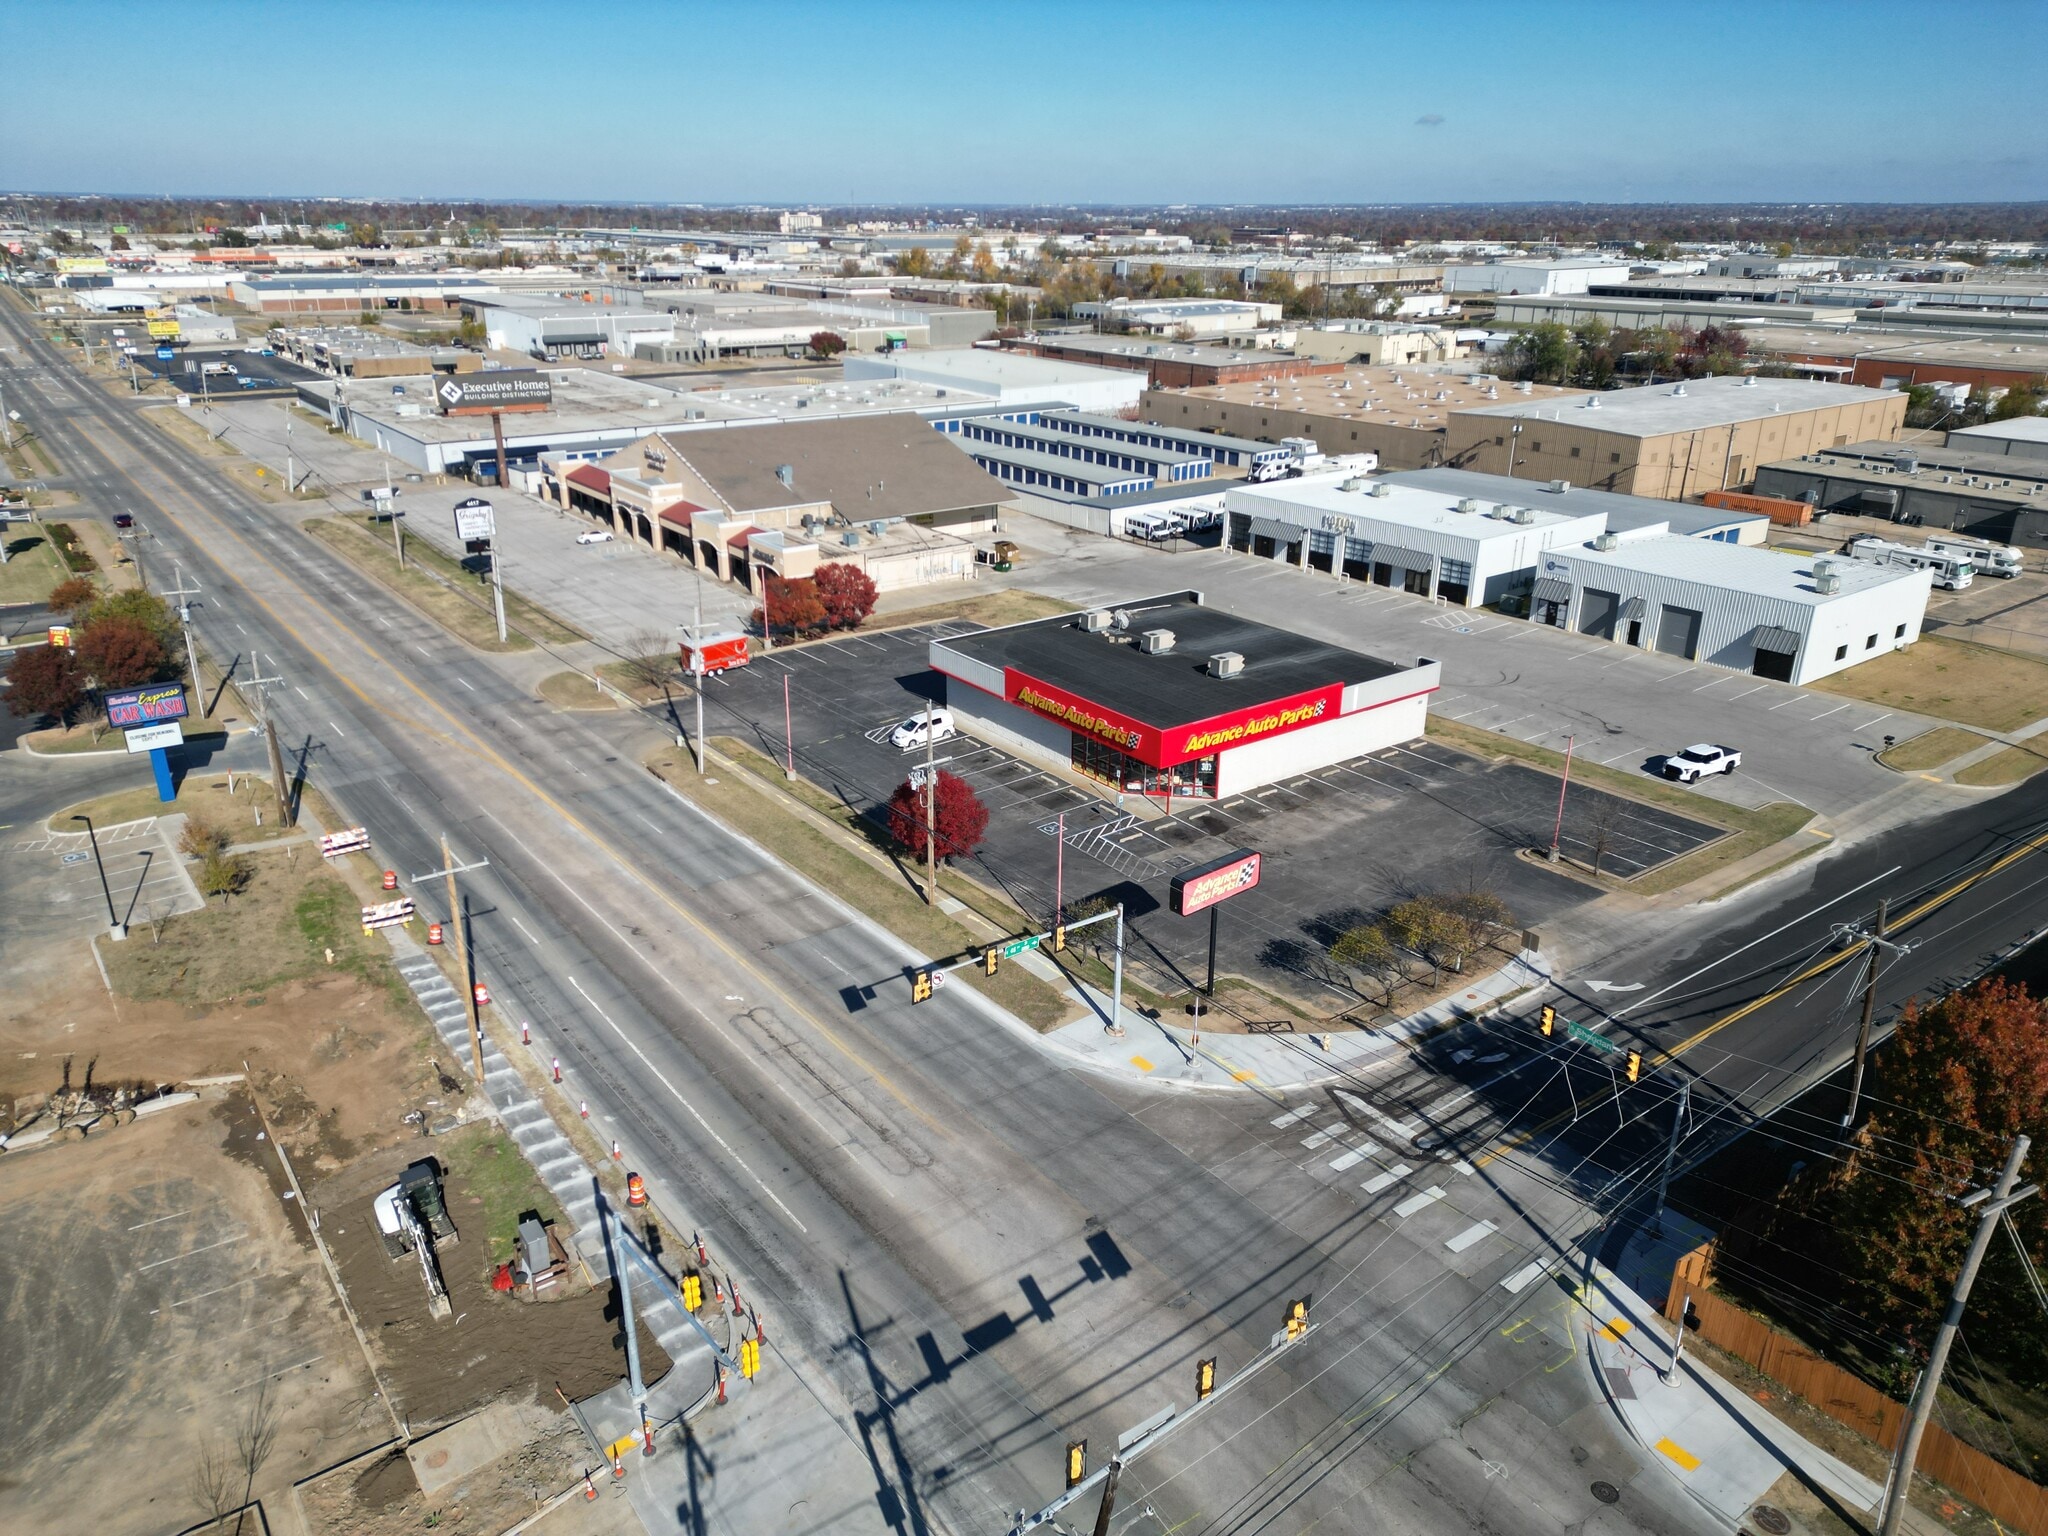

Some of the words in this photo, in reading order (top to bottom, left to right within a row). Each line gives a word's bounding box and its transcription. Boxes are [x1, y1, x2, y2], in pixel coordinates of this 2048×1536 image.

[462, 381, 512, 393] Executive
[514, 380, 549, 391] Homes
[464, 393, 500, 401] BUILDING
[53, 635, 65, 646] 5
[137, 688, 180, 705] Express
[111, 706, 141, 723] CAR
[142, 698, 184, 719] WASH
[1017, 686, 1065, 717] Advance
[1063, 706, 1094, 730] Auto
[1093, 719, 1129, 746] Parts
[1185, 726, 1243, 754] Advance
[1243, 716, 1279, 736] Auto
[1278, 703, 1316, 727] Parts
[1193, 869, 1240, 896] Advance
[1211, 881, 1236, 899] Parts
[1187, 892, 1211, 909] Auto
